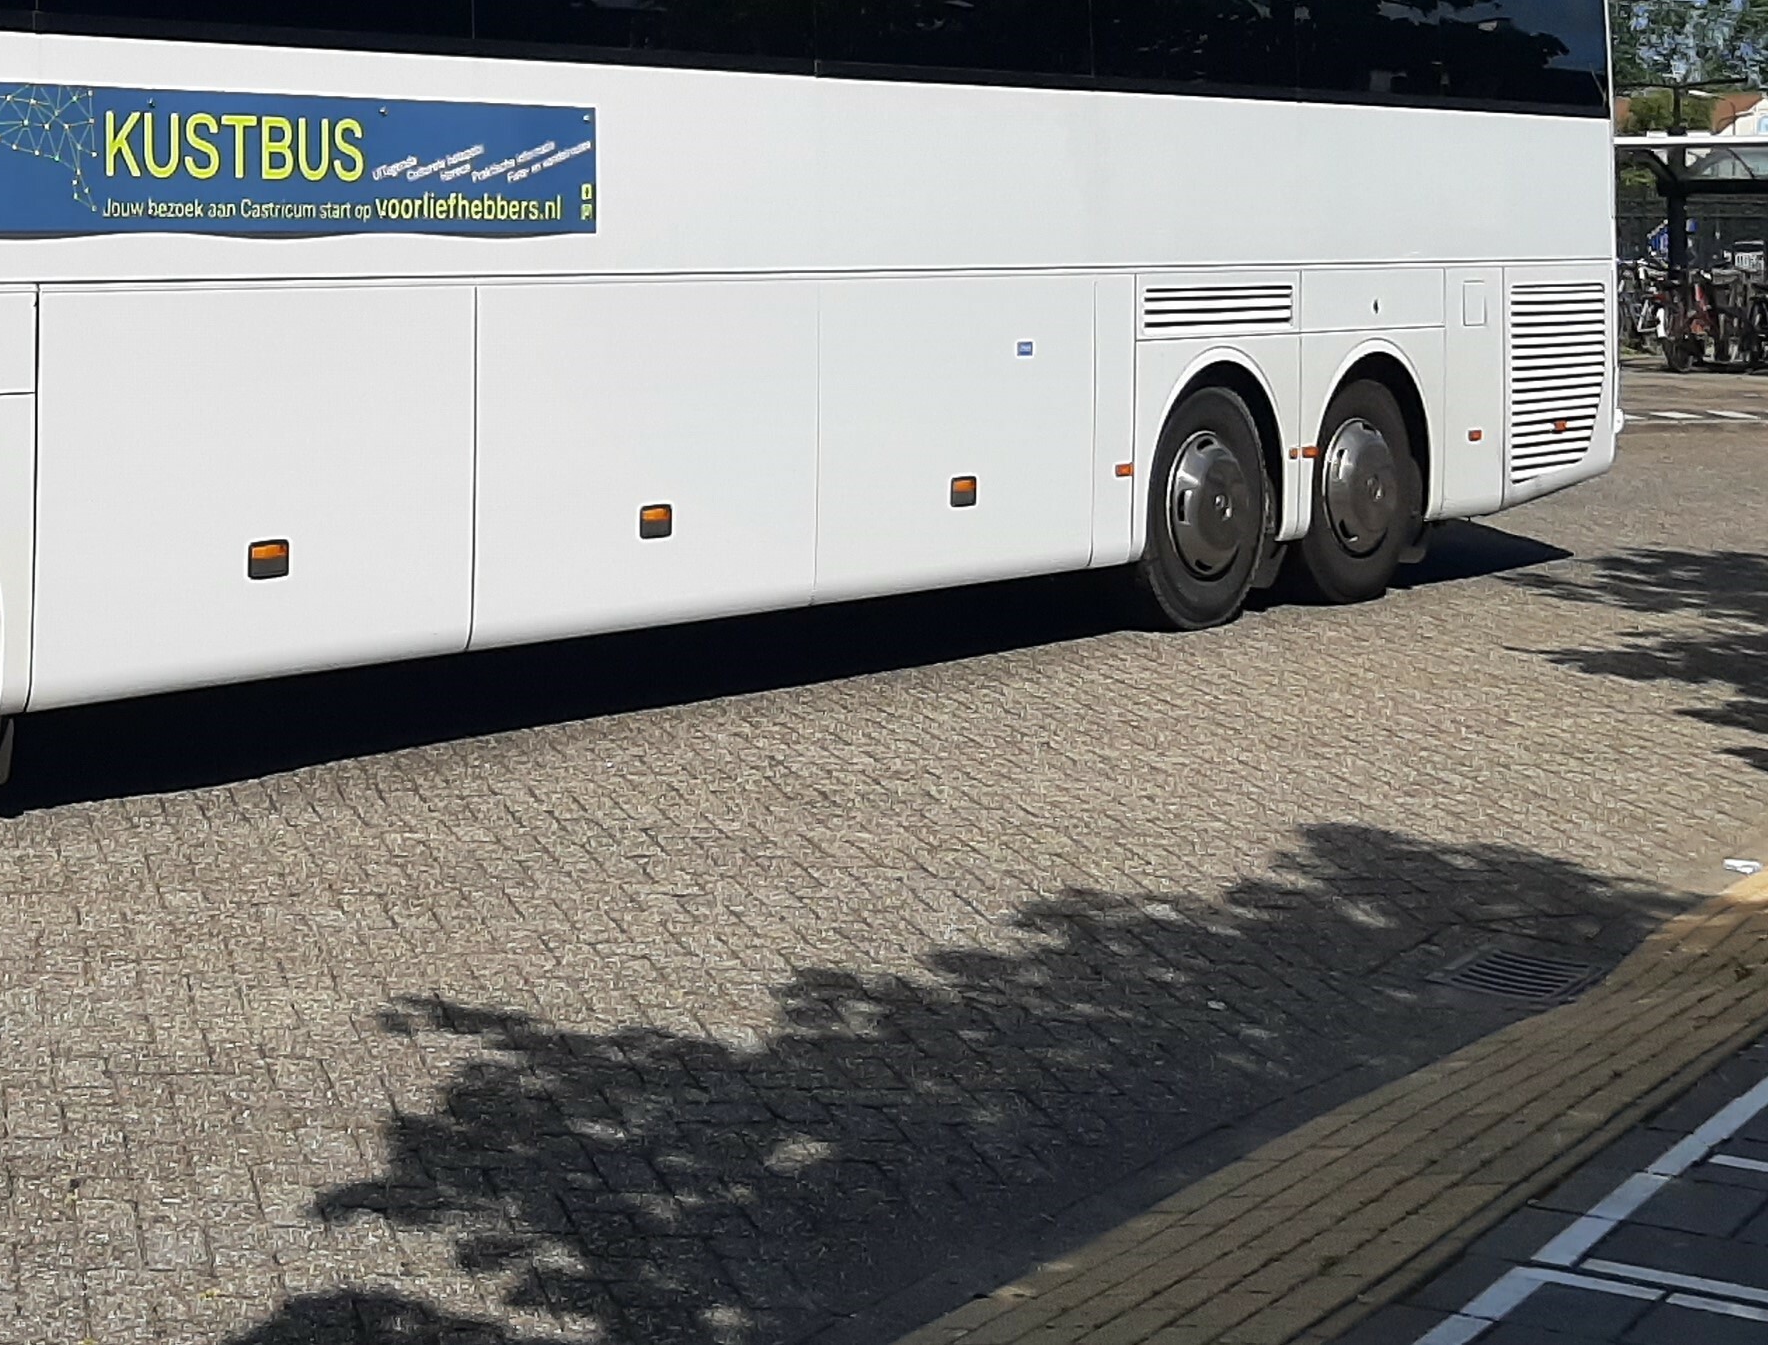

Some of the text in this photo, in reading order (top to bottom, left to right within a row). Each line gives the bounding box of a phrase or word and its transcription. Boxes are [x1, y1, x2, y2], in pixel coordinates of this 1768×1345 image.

[105, 110, 365, 182] KUSTBUS
[103, 192, 562, 222] Jouw bezoek aan Castricum start op voorliefhebbers.nl
